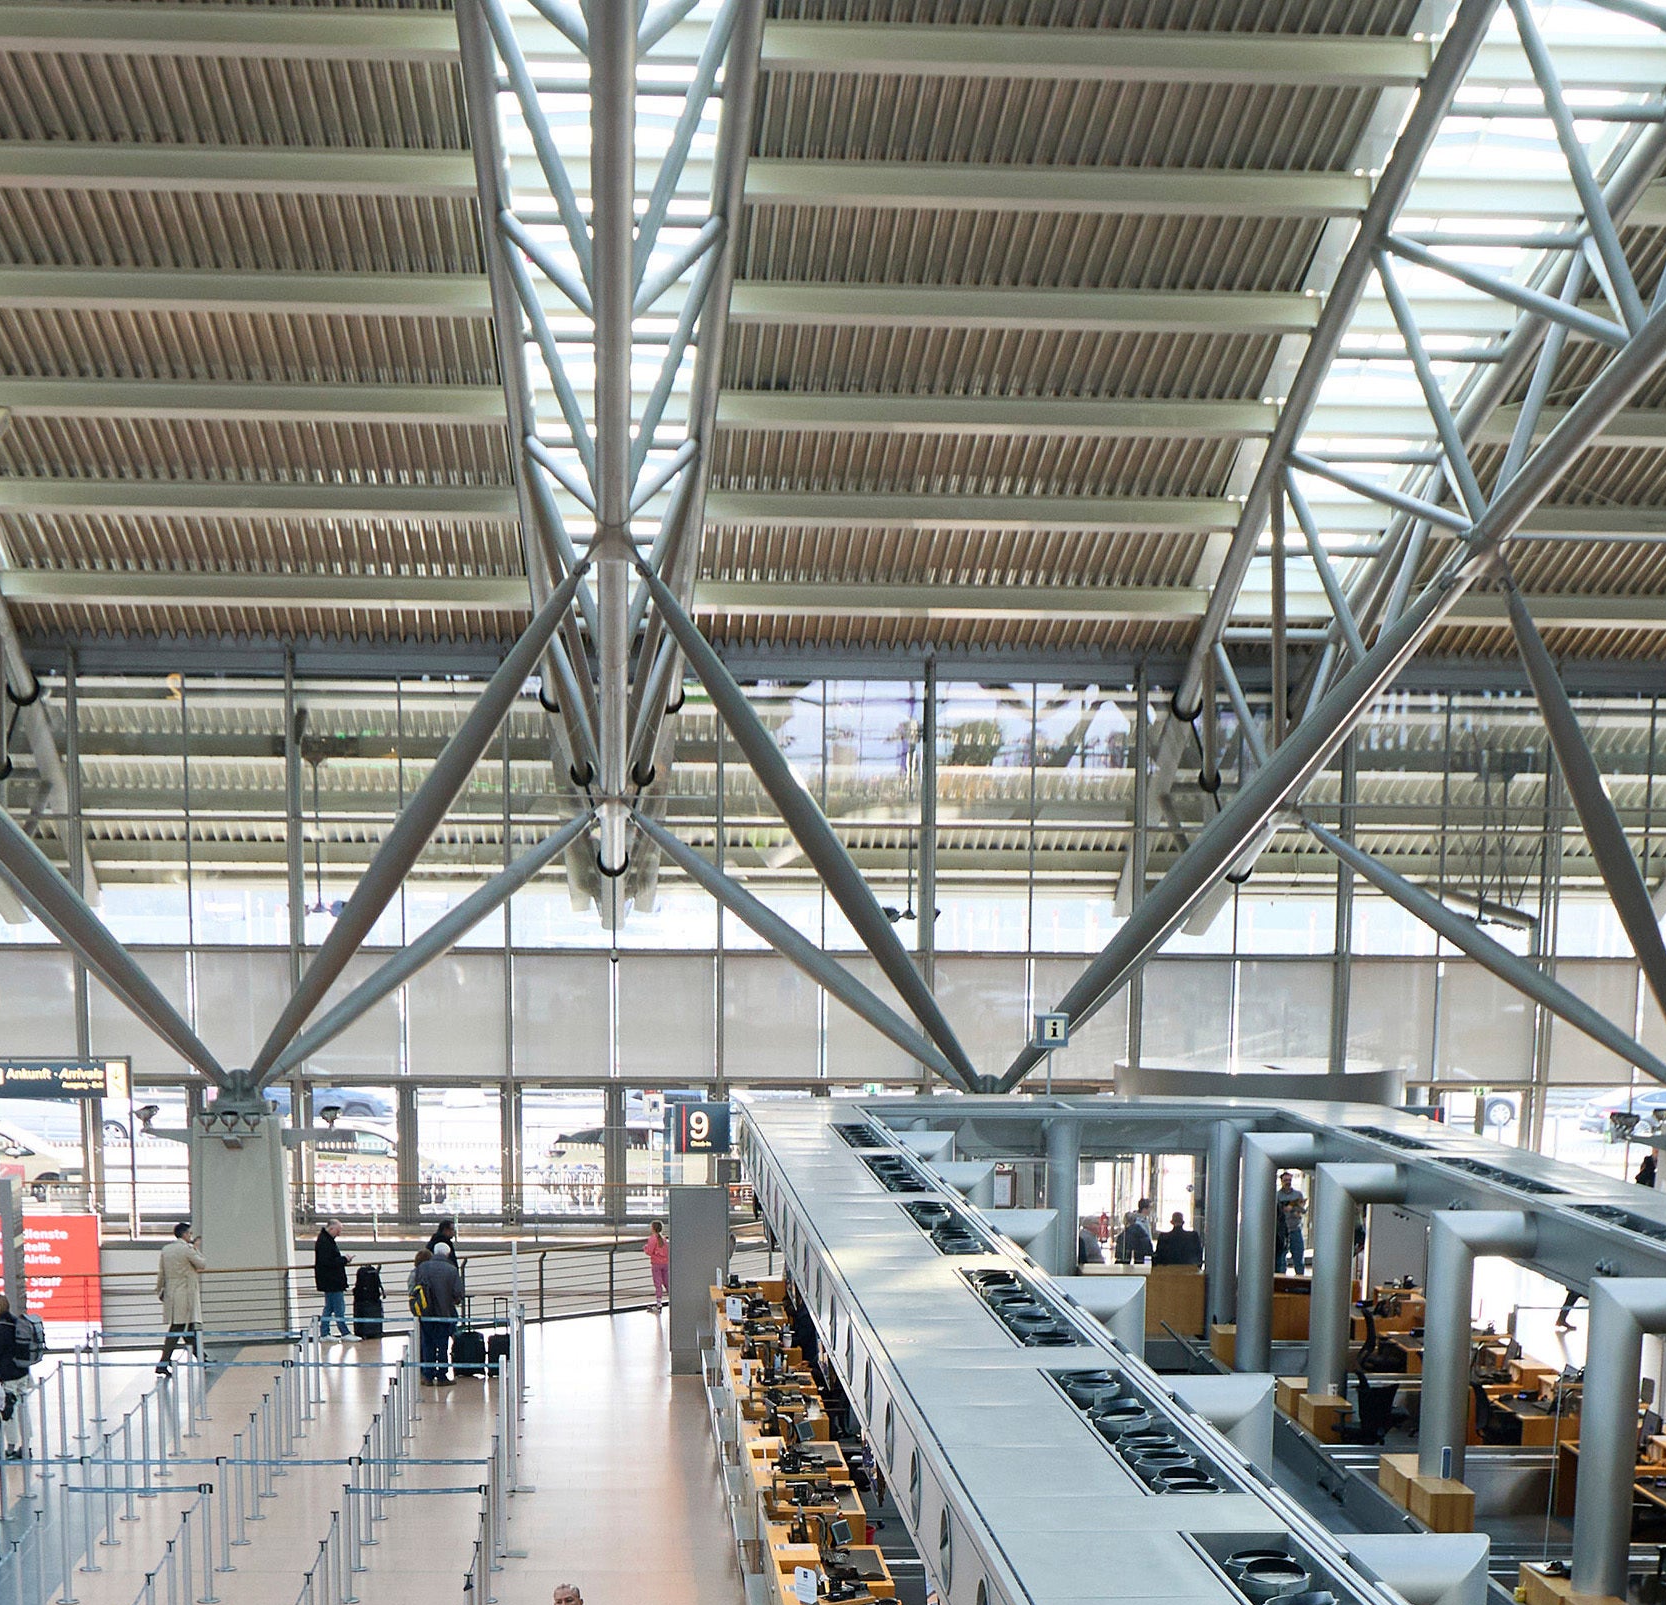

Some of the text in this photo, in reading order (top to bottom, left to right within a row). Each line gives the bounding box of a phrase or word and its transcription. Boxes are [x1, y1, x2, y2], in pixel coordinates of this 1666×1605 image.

[6, 1067, 104, 1080] Ankunft Arrivals
[689, 1110, 709, 1140] 9
